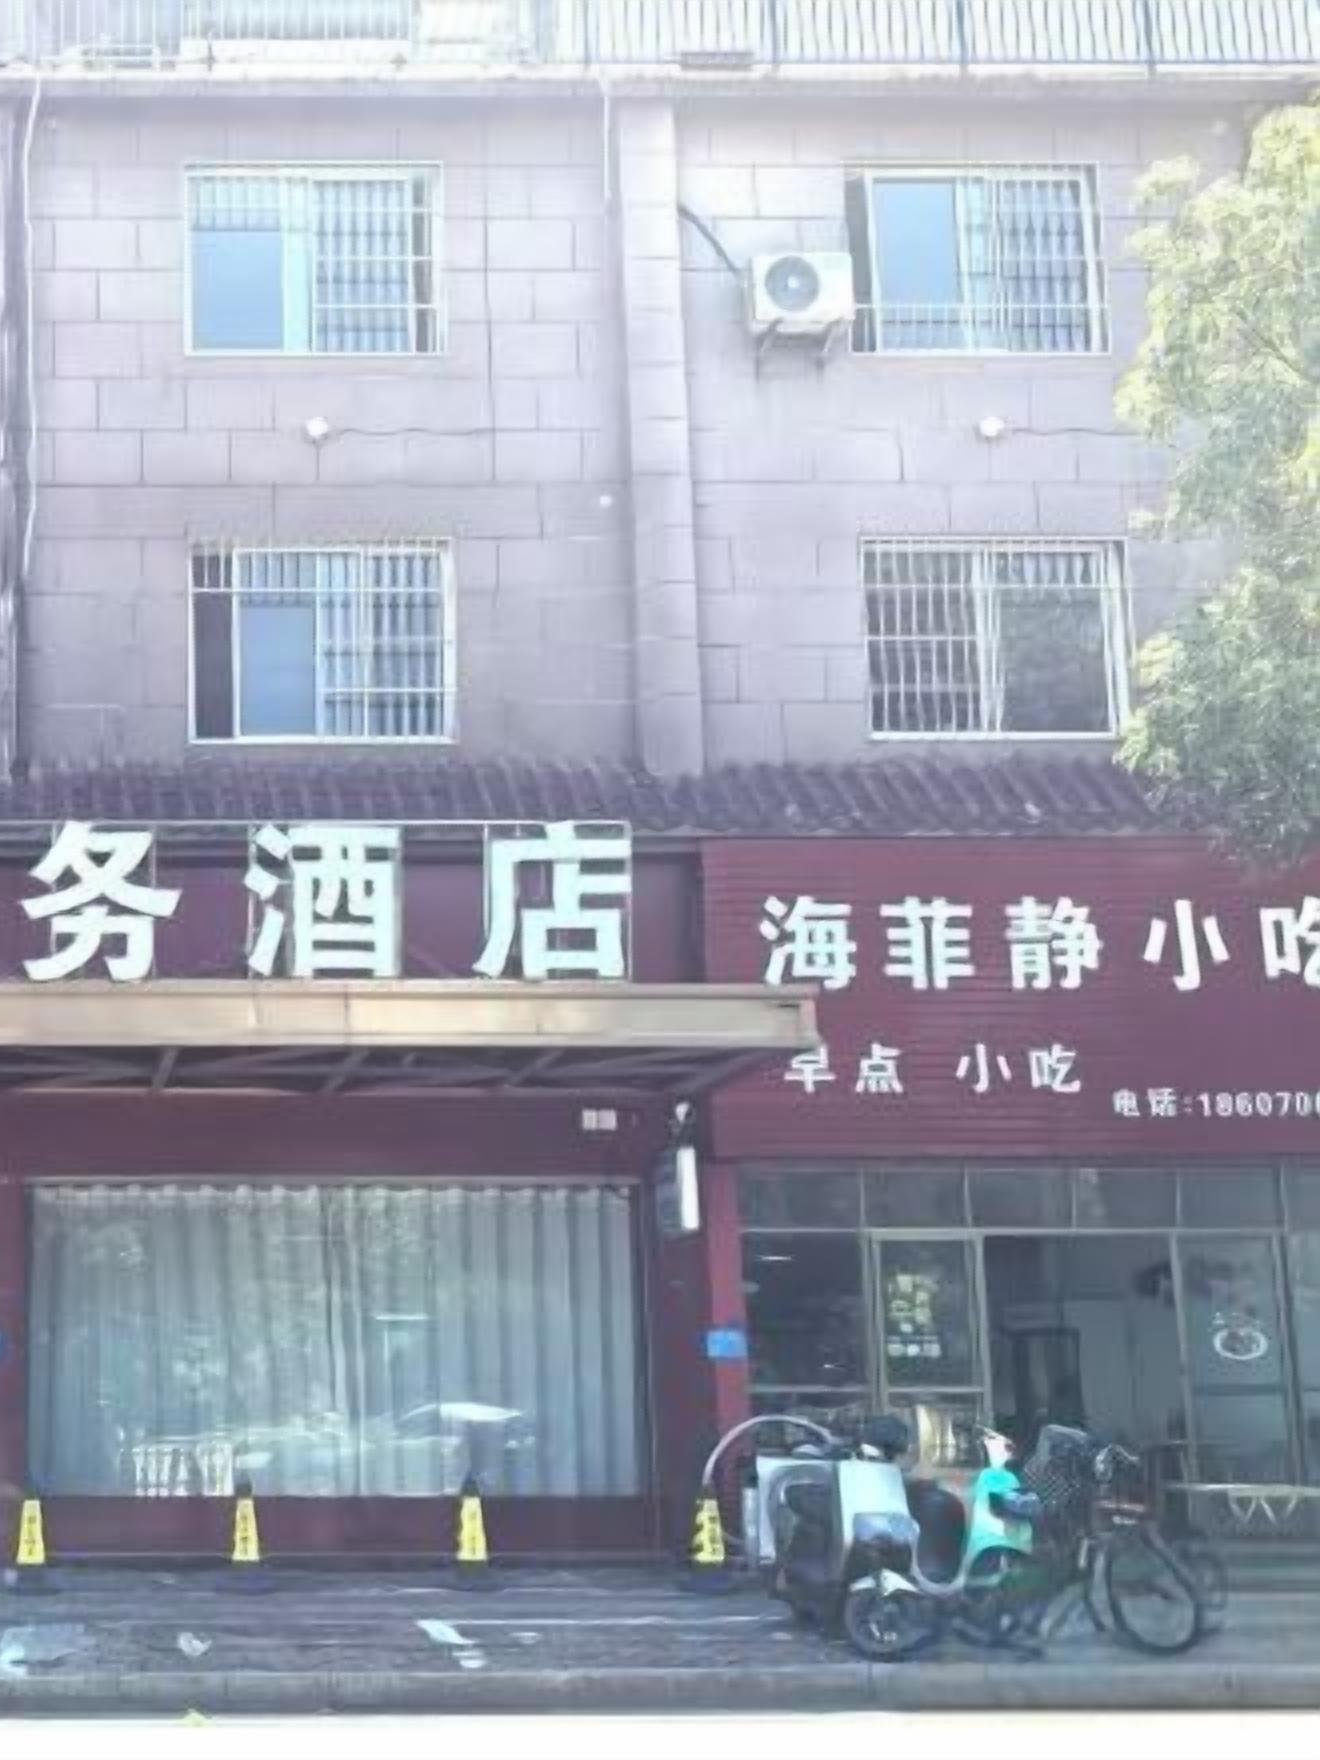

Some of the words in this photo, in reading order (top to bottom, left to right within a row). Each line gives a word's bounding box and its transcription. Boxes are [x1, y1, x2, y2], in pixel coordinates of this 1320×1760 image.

[783, 1042, 904, 1094] 早点
[955, 1042, 1082, 1094] 小吃
[1112, 1087, 1320, 1118] 电话:186070
